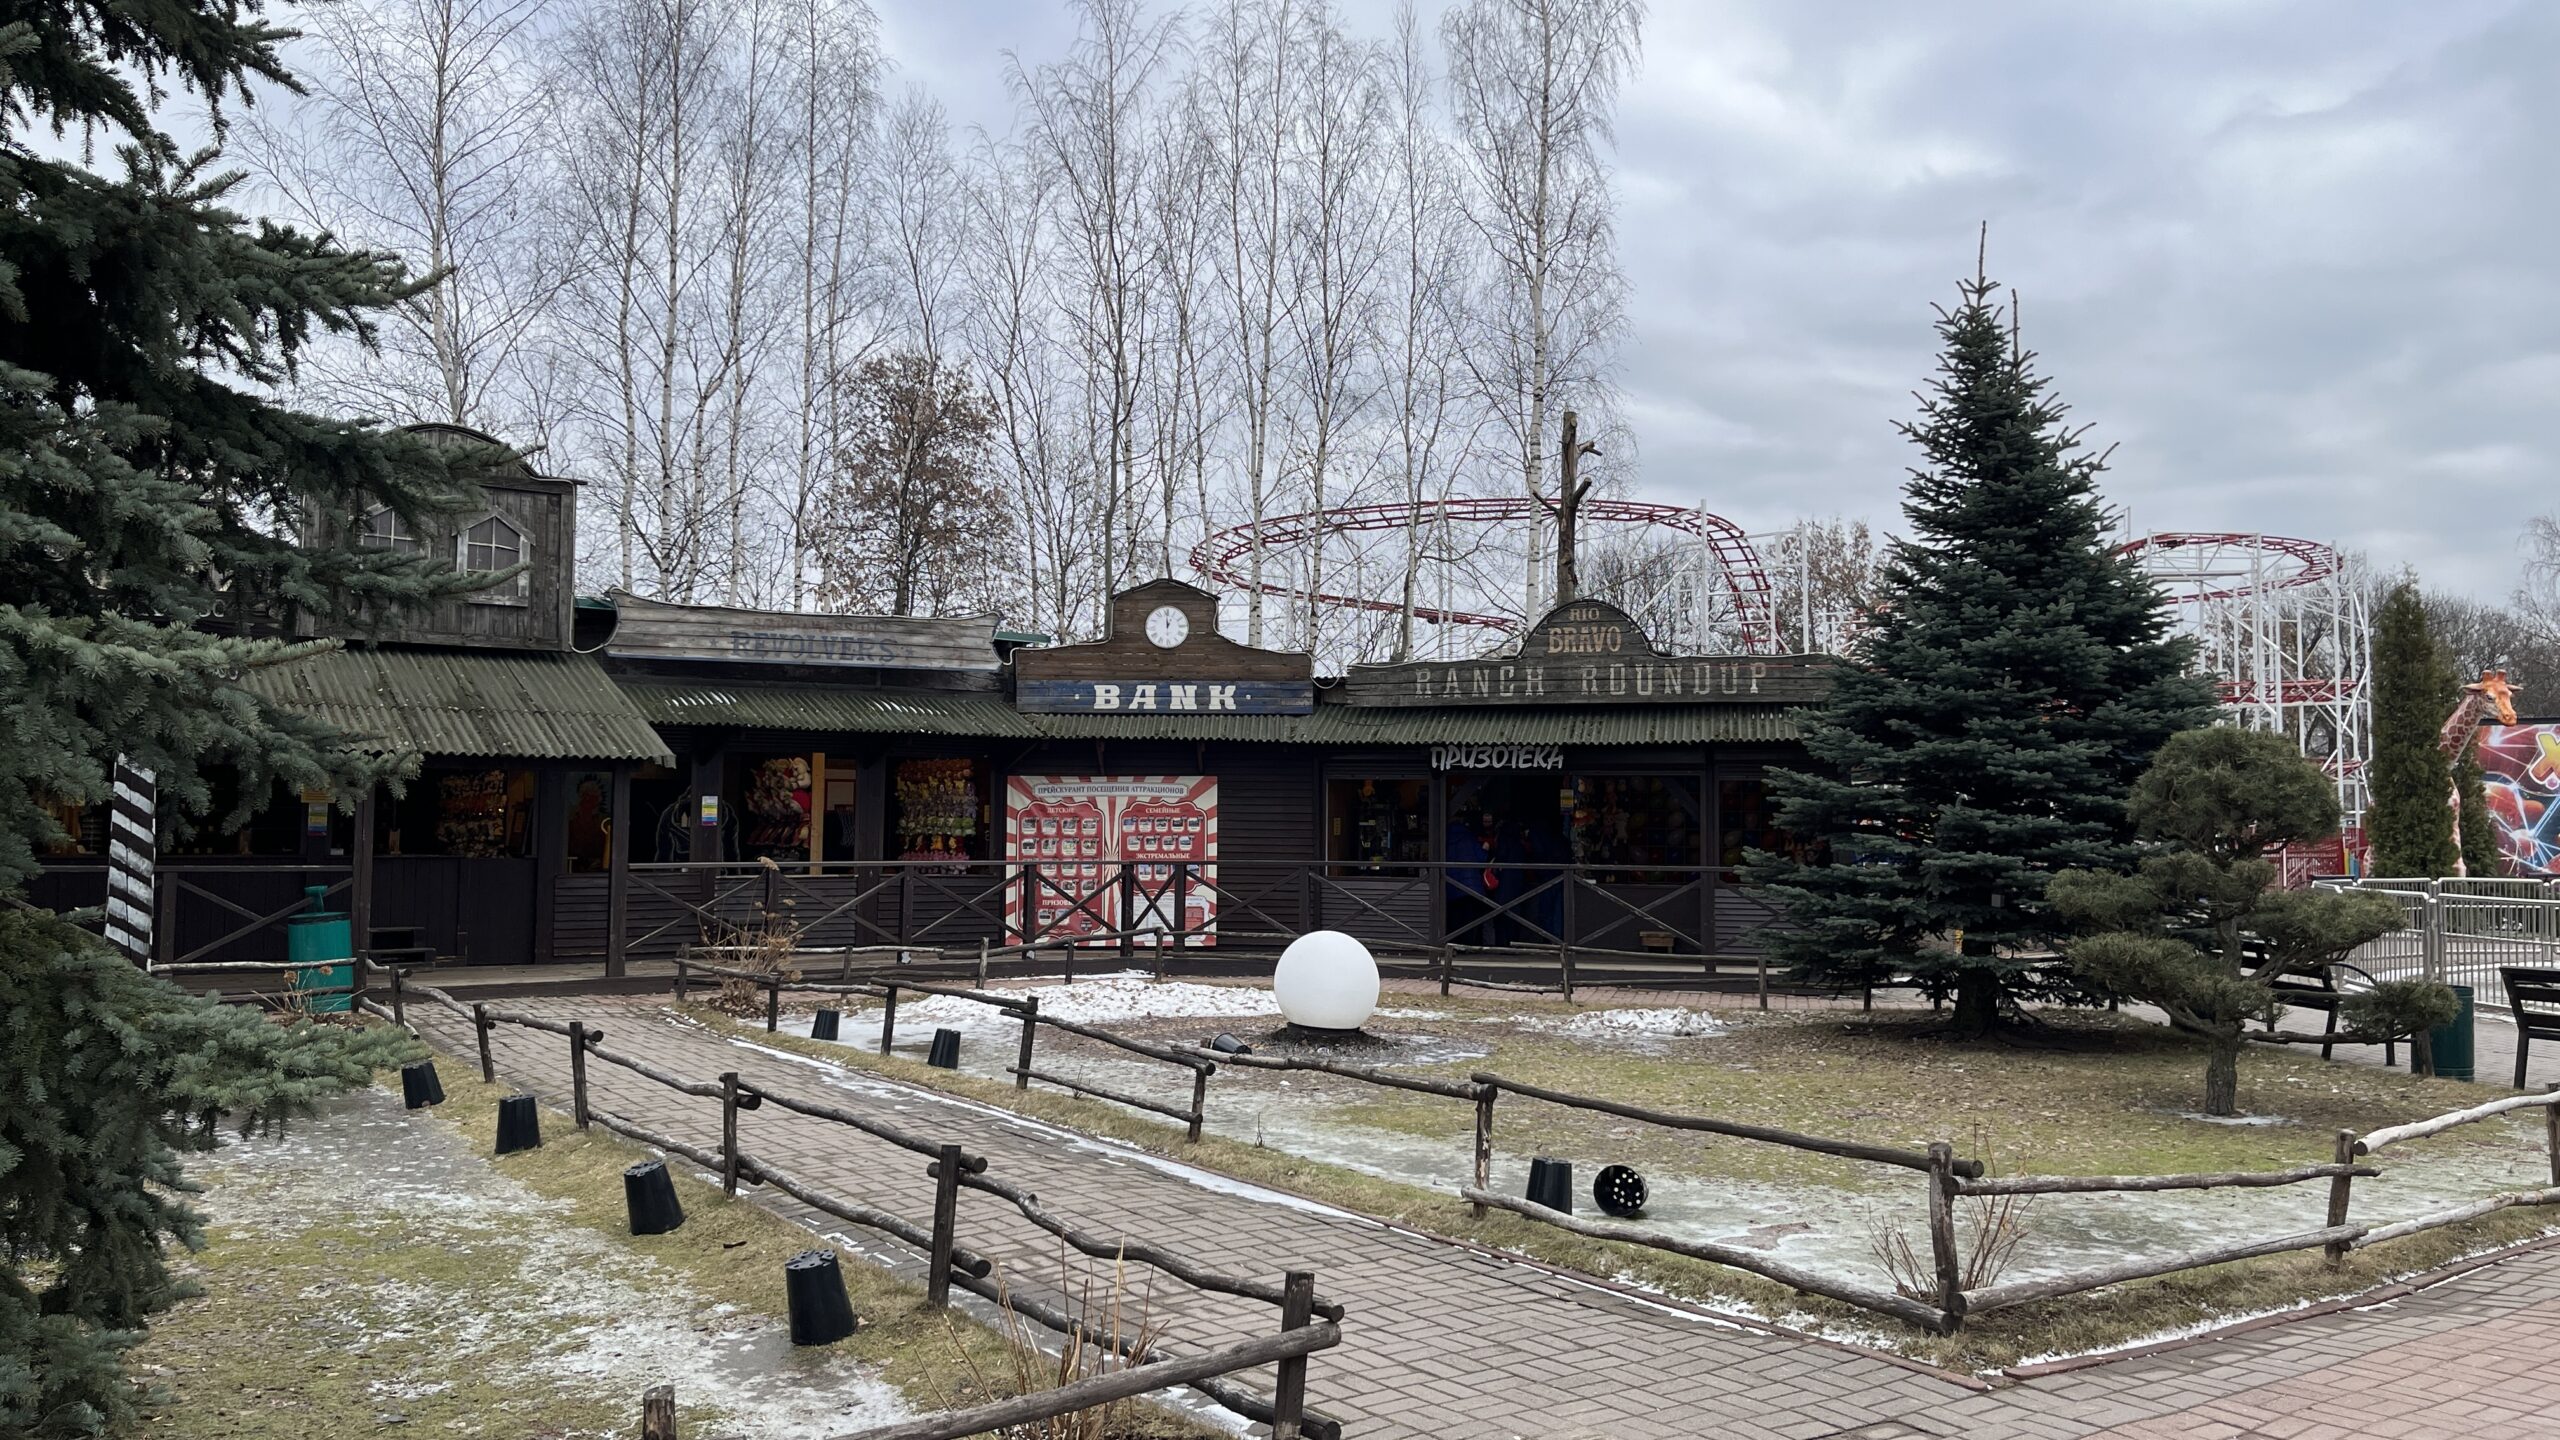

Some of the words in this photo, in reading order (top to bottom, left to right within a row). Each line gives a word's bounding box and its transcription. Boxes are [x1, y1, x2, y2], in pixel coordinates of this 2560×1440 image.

[1569, 608, 1599, 621] RIO
[730, 630, 899, 663] REVOLVERS
[1547, 624, 1622, 654] BRAVO
[1414, 665, 1545, 700] RANCH
[1580, 662, 1768, 697] ROUNDUP
[1093, 683, 1237, 711] BANK
[1430, 744, 1565, 772] ПРИЗОТЕКА
[1038, 785, 1085, 794] ПРЕЙСКУРАНТ
[1086, 785, 1130, 794] ПОСЕЩЕНИЯ
[1130, 785, 1184, 795] АТТРАКЦИОНОВ
[1145, 806, 1181, 814] СЕМЕЙНЫЕ
[1135, 852, 1191, 860] ЭКСТРЕМАЛЬНЫЕ
